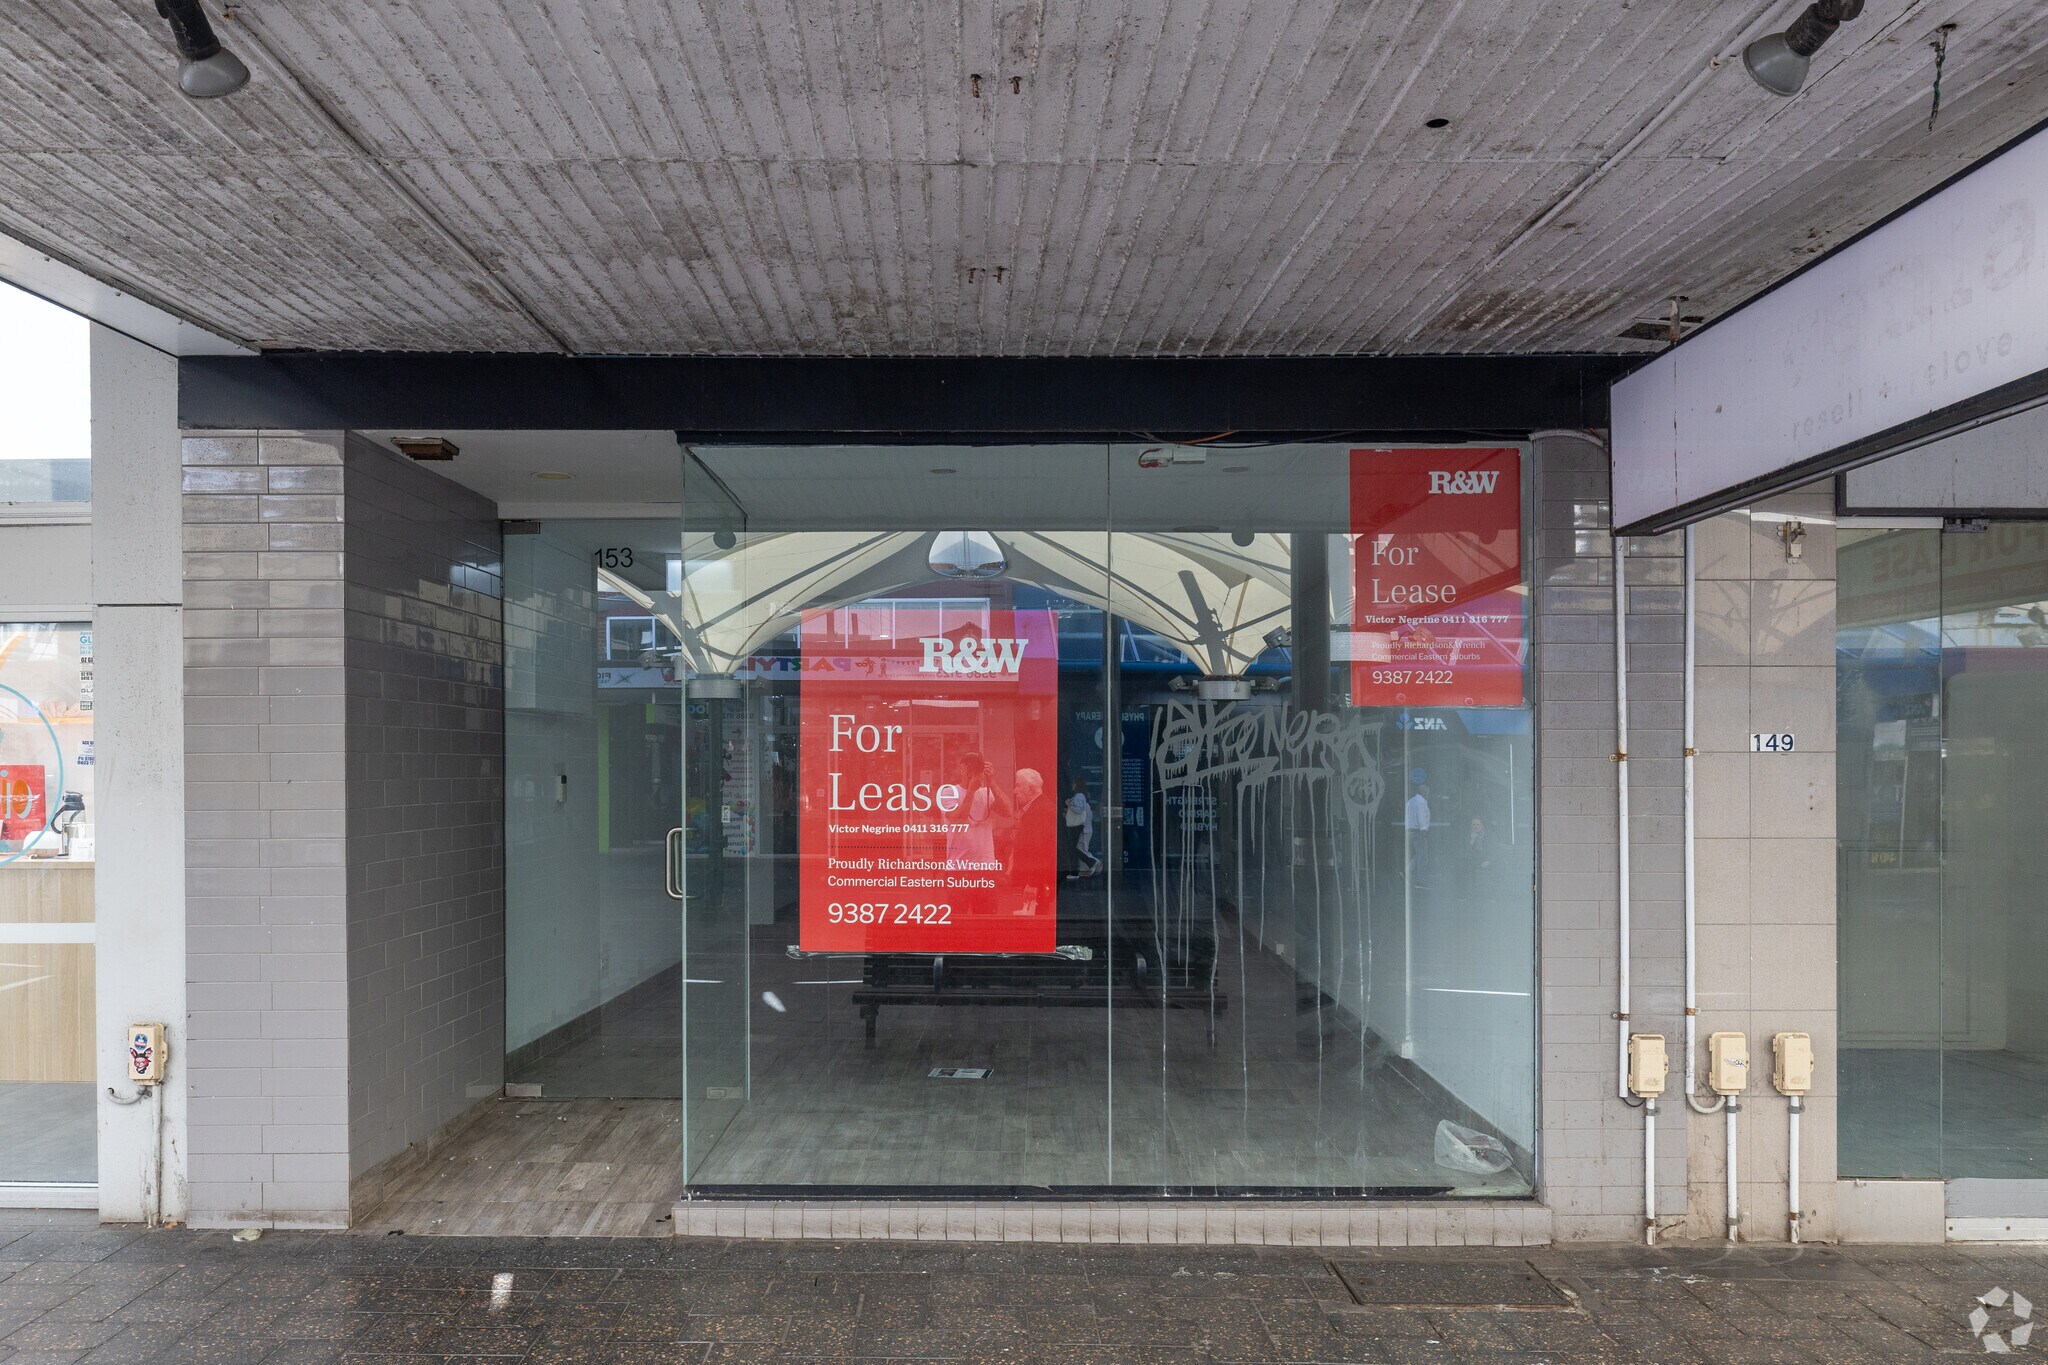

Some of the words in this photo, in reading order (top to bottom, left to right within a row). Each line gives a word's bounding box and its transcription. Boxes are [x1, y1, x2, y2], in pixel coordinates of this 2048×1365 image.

[1428, 470, 1500, 495] R&W
[594, 548, 634, 569] 153
[1371, 541, 1419, 566] For
[1371, 579, 1457, 604] Lease
[1365, 615, 1396, 624] Victor
[1398, 615, 1440, 626] Negrine
[1442, 615, 1466, 624] 0411
[1469, 615, 1488, 624] 316
[1490, 615, 1509, 624] 777
[918, 637, 1029, 674] R&W
[1372, 641, 1402, 651] Proudly
[1404, 641, 1486, 650] Richardson&Wrench
[1371, 652, 1418, 661] Commercial
[1418, 652, 1448, 661] Eastern
[1449, 652, 1481, 661] Suburbs
[1372, 670, 1411, 685] 9387
[1415, 670, 1453, 685] 2422
[828, 714, 903, 753] For
[1753, 734, 1794, 751] 149
[828, 772, 960, 812] Lease
[828, 824, 860, 833] Victor
[861, 824, 901, 835] Negrine
[902, 824, 928, 833] 0411
[929, 824, 948, 833] 316
[950, 824, 970, 833] 777
[828, 857, 875, 872] Proudly
[877, 858, 1003, 871] Richardson&Wrench
[827, 875, 897, 888] Commercial
[899, 876, 945, 888] Eastern
[946, 876, 995, 889] Suburbs
[828, 902, 890, 924] 9387
[893, 903, 952, 925] 2422
